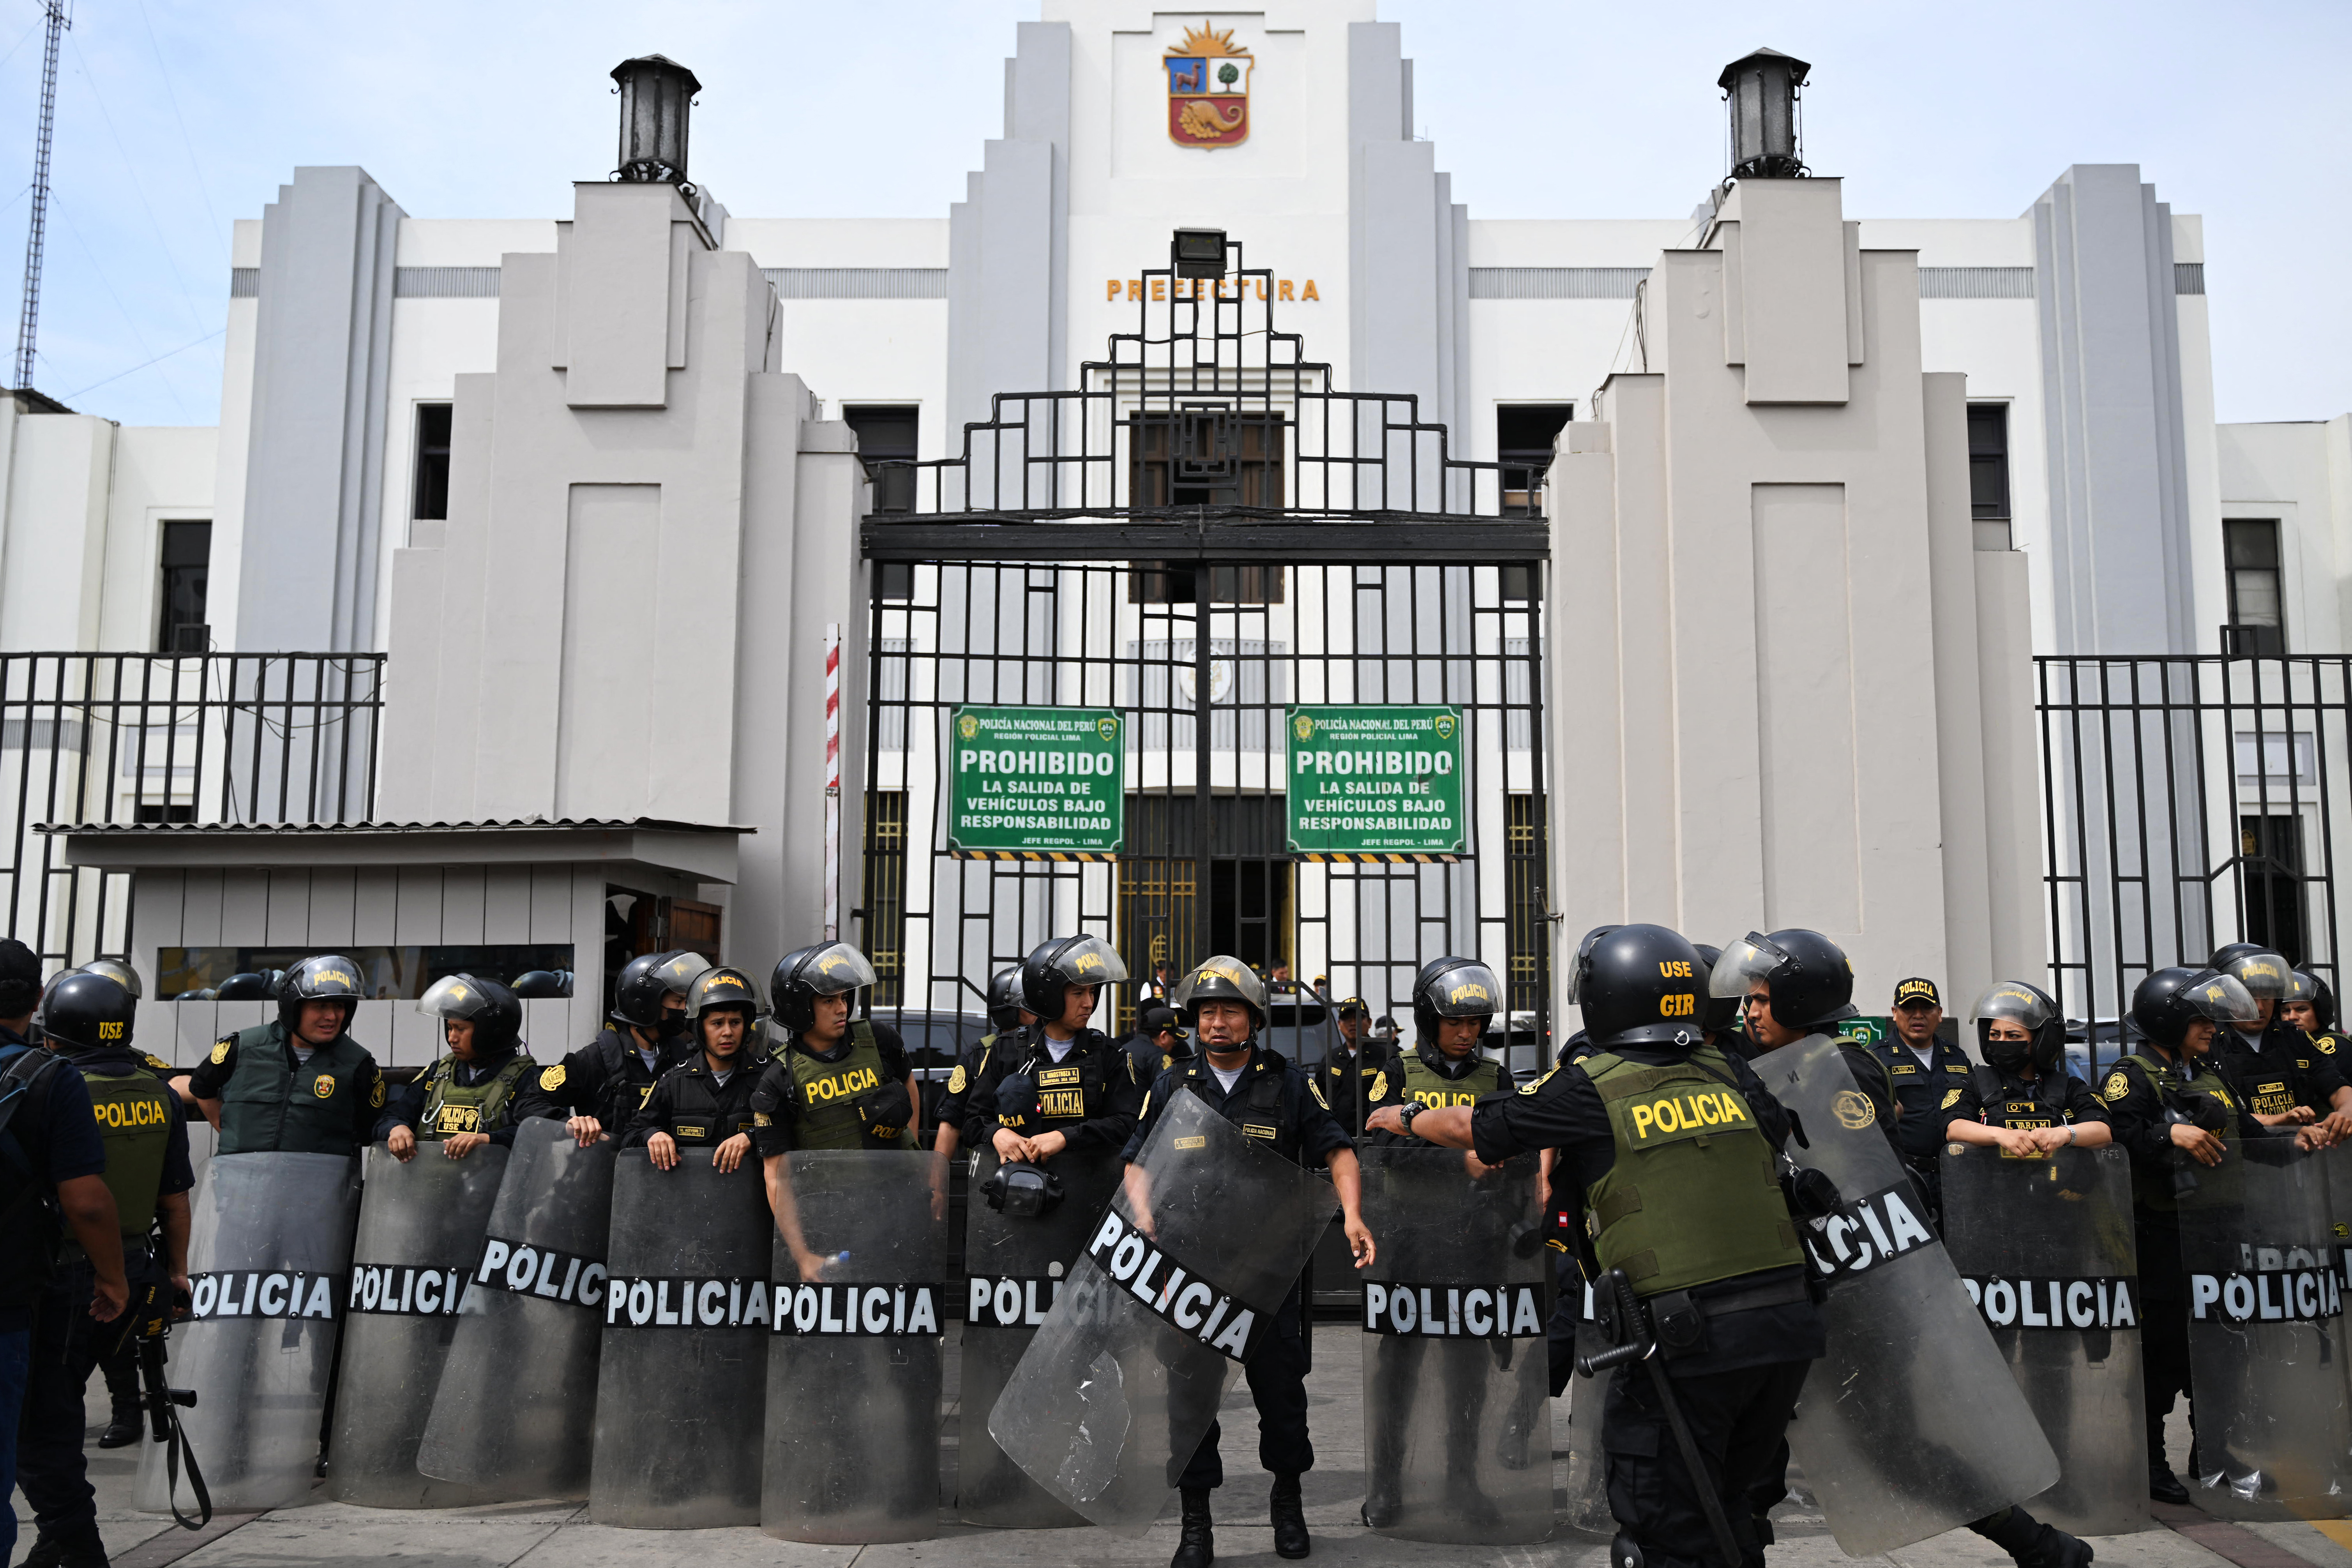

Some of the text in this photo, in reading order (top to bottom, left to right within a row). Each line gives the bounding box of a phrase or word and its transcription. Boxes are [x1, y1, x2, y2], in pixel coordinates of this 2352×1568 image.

[1107, 280, 1319, 301] PREFECTURA
[980, 717, 1095, 731] POLICÍA NACIONAL DEL PERÚ
[1315, 717, 1433, 730] POLICÍA NACIONAL DEL PERÚ
[960, 750, 1113, 775] PROHIBIDO
[1297, 751, 1452, 775] PROHIBIDO
[983, 780, 1090, 795] LA SALIDA DE
[1320, 782, 1429, 794] LA SALIDA DE
[967, 795, 1105, 812] VEHÍCULOS BAJO
[1305, 797, 1445, 812] VEHÍCULOS BAJO
[961, 816, 1111, 830] RESPONSABILIDAD
[1300, 818, 1451, 830] RESPONSABILIDAD
[1197, 968, 1240, 985] POLICIA
[1660, 961, 1692, 977] USE
[2242, 963, 2278, 980] POLICIA
[314, 970, 350, 988] POLICIA
[704, 976, 744, 993] POLICIA
[1451, 984, 1488, 1005] POLICIA
[1899, 981, 1933, 998] POLICIA
[1660, 994, 1694, 1017] GIR
[99, 1022, 123, 1039] USE
[1047, 1070, 1071, 1079] HINOSTROZA
[806, 1068, 879, 1104] POLICIA
[1039, 1092, 1082, 1115] POLICIA
[1415, 1091, 1481, 1110] POLICI
[2253, 1093, 2294, 1109] POLICIA
[94, 1101, 166, 1127] POLICIA
[440, 1107, 465, 1124] POLICIA
[1632, 1093, 1746, 1138] POLICIA
[1090, 1211, 1255, 1358] POLICIA
[147, 1286, 155, 1304] PERU
[607, 1280, 770, 1325] POLICIA
[2192, 1270, 2341, 1319] POLICIA
[774, 1287, 937, 1333] POLICIA
[1367, 1284, 1541, 1336] POLICIA
